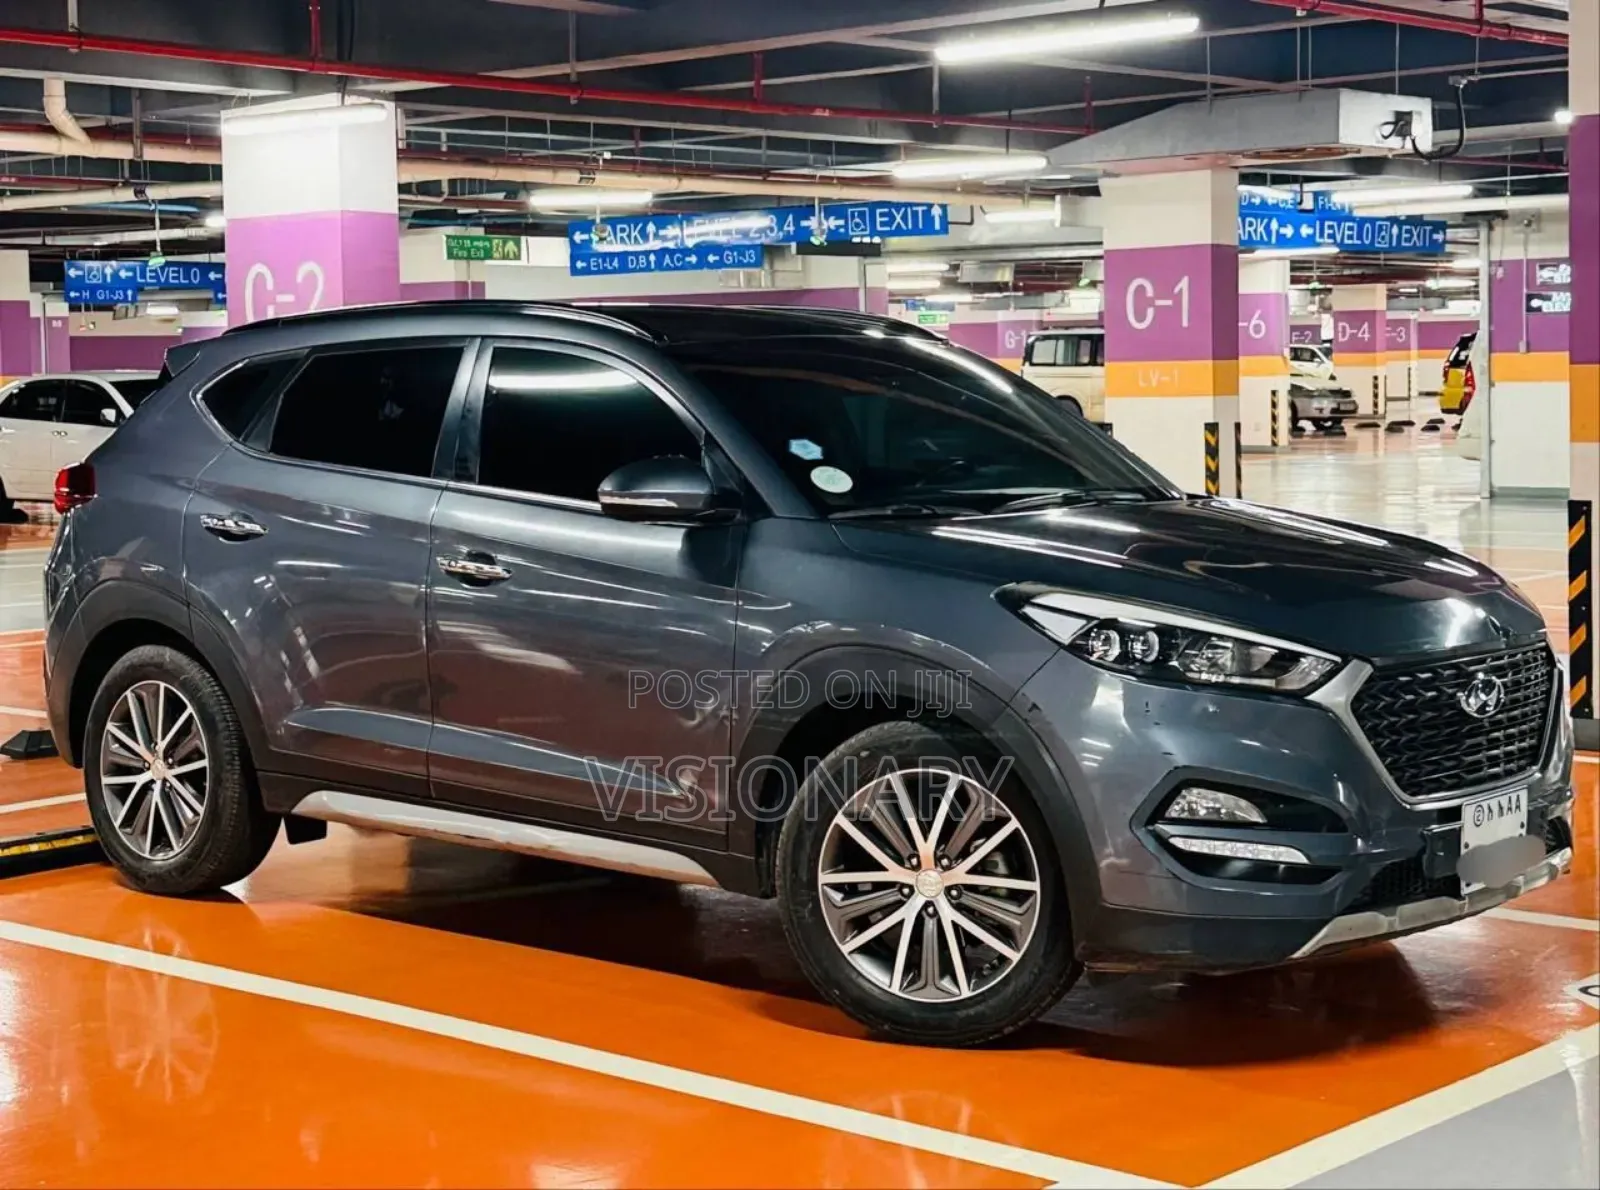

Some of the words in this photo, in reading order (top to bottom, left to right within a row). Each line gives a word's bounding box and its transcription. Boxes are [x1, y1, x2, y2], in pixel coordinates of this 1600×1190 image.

[594, 221, 644, 246] ARK
[875, 205, 928, 231] EXIT
[1237, 216, 1269, 242] ARK
[1401, 225, 1433, 247] EXIT
[590, 256, 620, 271] E1-L4
[628, 255, 647, 270] D,B
[663, 253, 684, 268] A,C
[723, 250, 756, 265] G1-J3
[82, 289, 90, 300] H
[96, 289, 125, 301] G1-J3
[244, 262, 325, 322] C-2
[1126, 275, 1190, 330] C-1
[1238, 310, 1266, 339] -6
[1338, 321, 1371, 342] D-4
